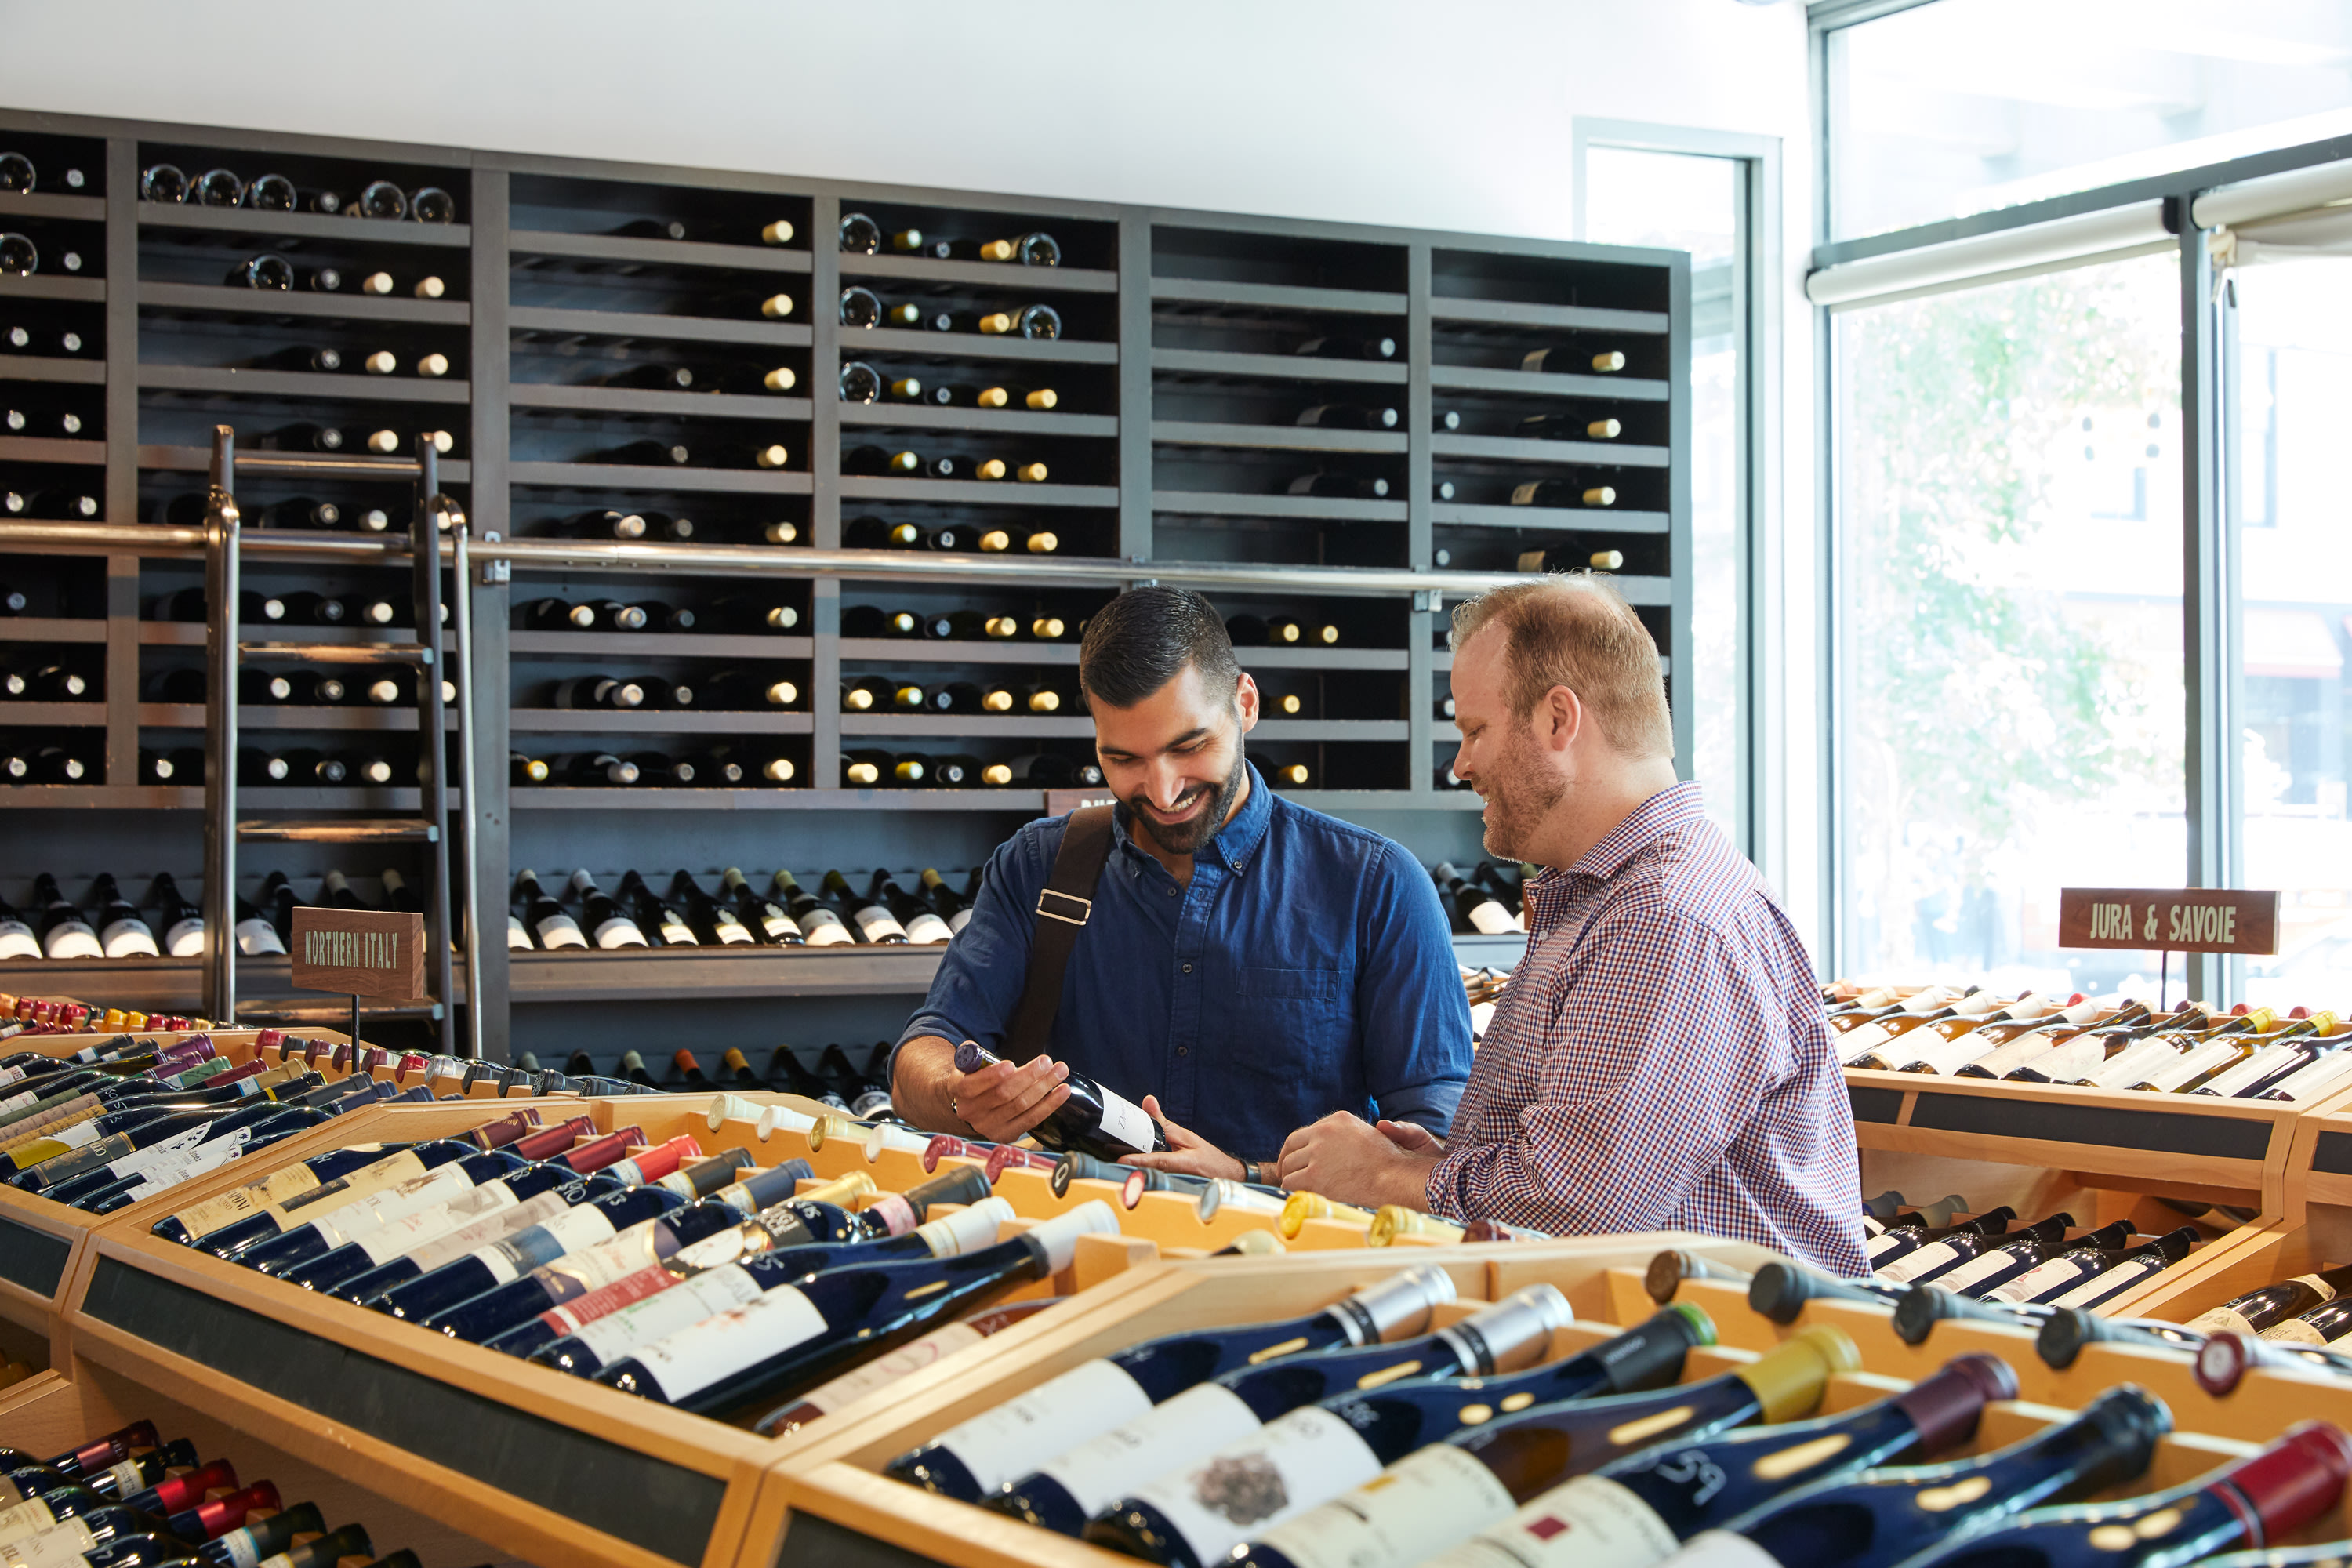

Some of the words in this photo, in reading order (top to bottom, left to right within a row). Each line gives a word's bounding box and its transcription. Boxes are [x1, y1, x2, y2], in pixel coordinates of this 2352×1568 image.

[2090, 903, 2133, 940] JURA
[2143, 904, 2158, 941] &
[2169, 905, 2237, 944] SAVOIE
[305, 931, 359, 968] NORTHERN
[365, 931, 397, 969] ITALY
